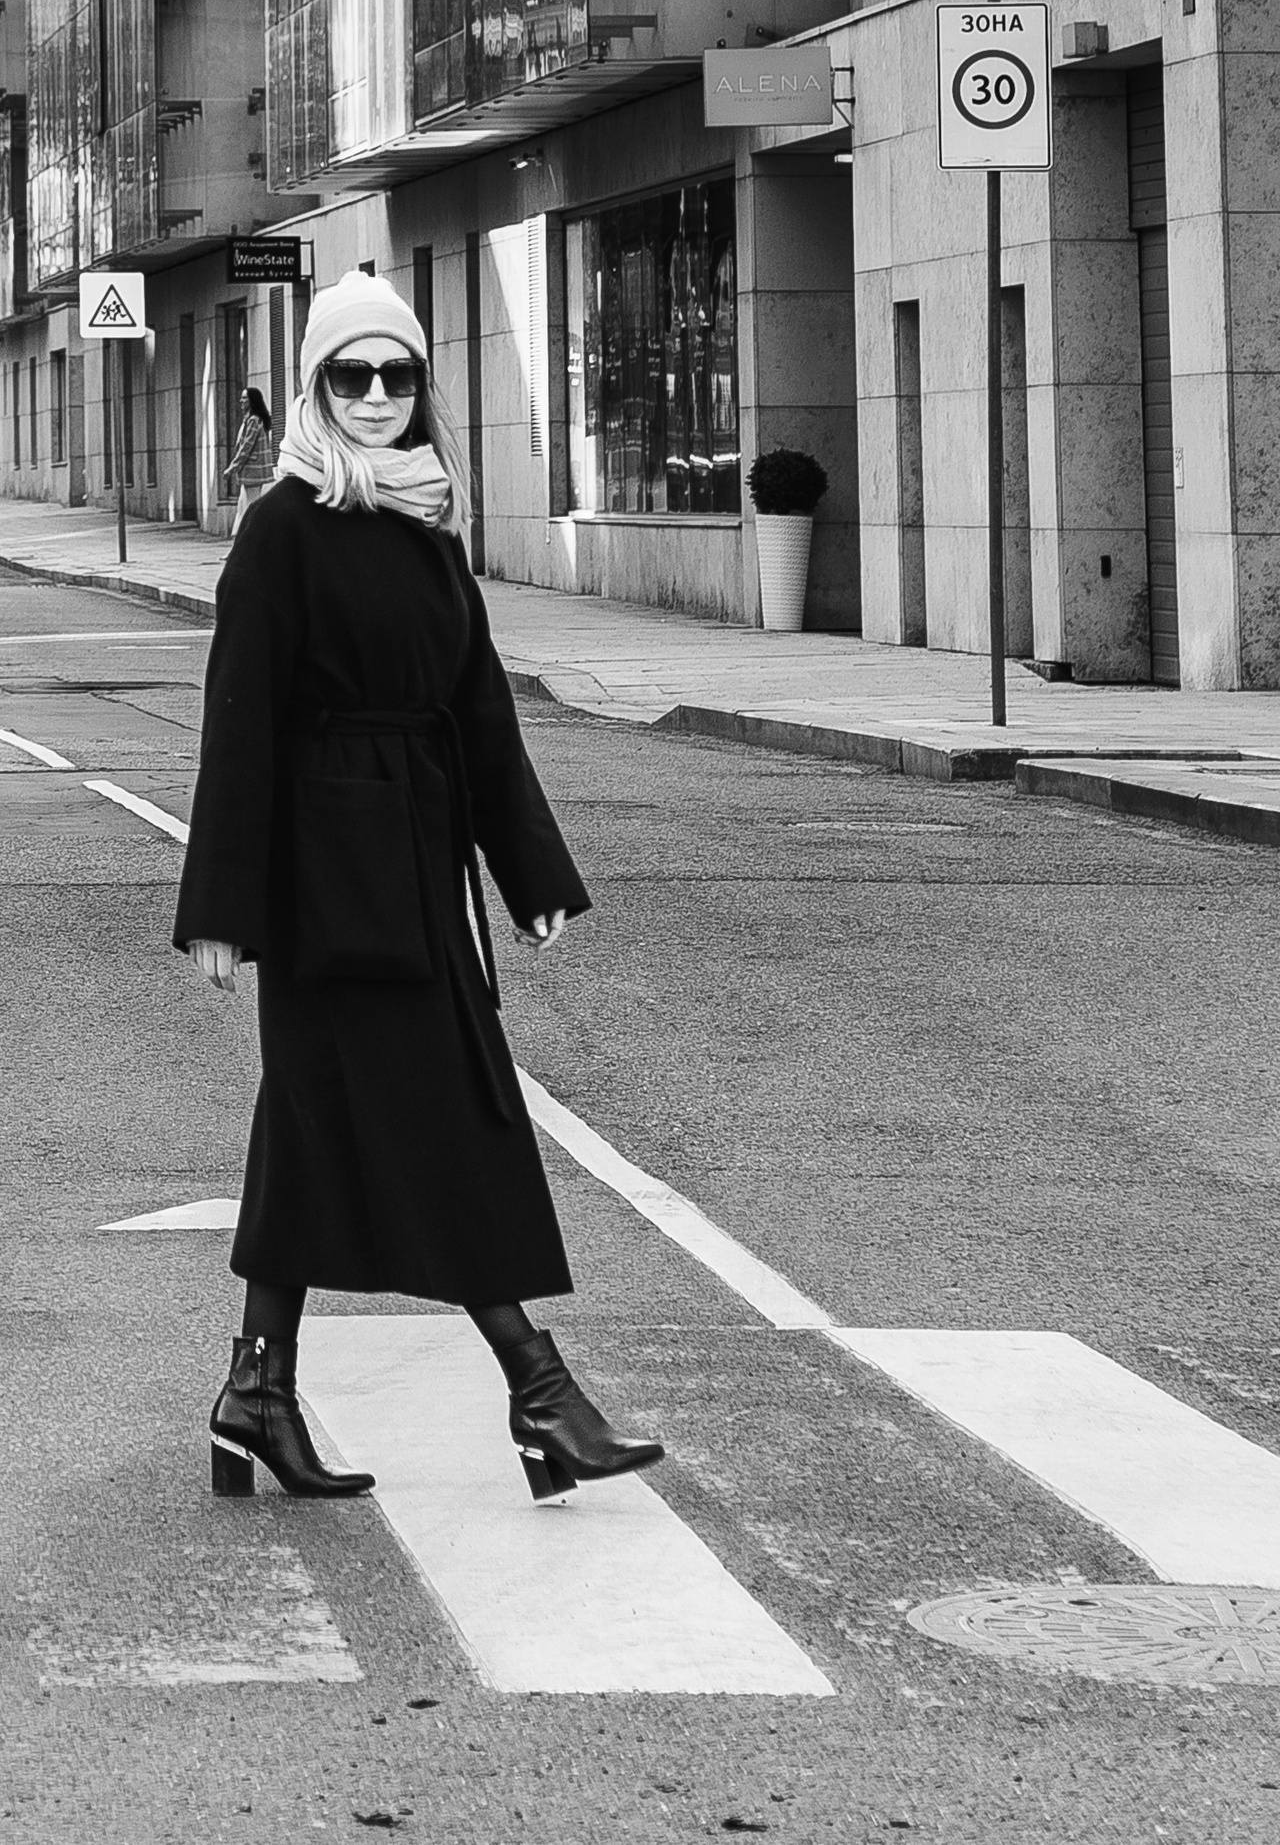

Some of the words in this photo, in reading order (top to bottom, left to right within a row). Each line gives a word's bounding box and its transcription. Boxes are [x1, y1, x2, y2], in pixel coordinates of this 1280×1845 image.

[961, 14, 1024, 33] ЗОНА
[716, 75, 821, 93] ALENA
[971, 74, 1016, 105] 30
[237, 254, 295, 266] WineState
